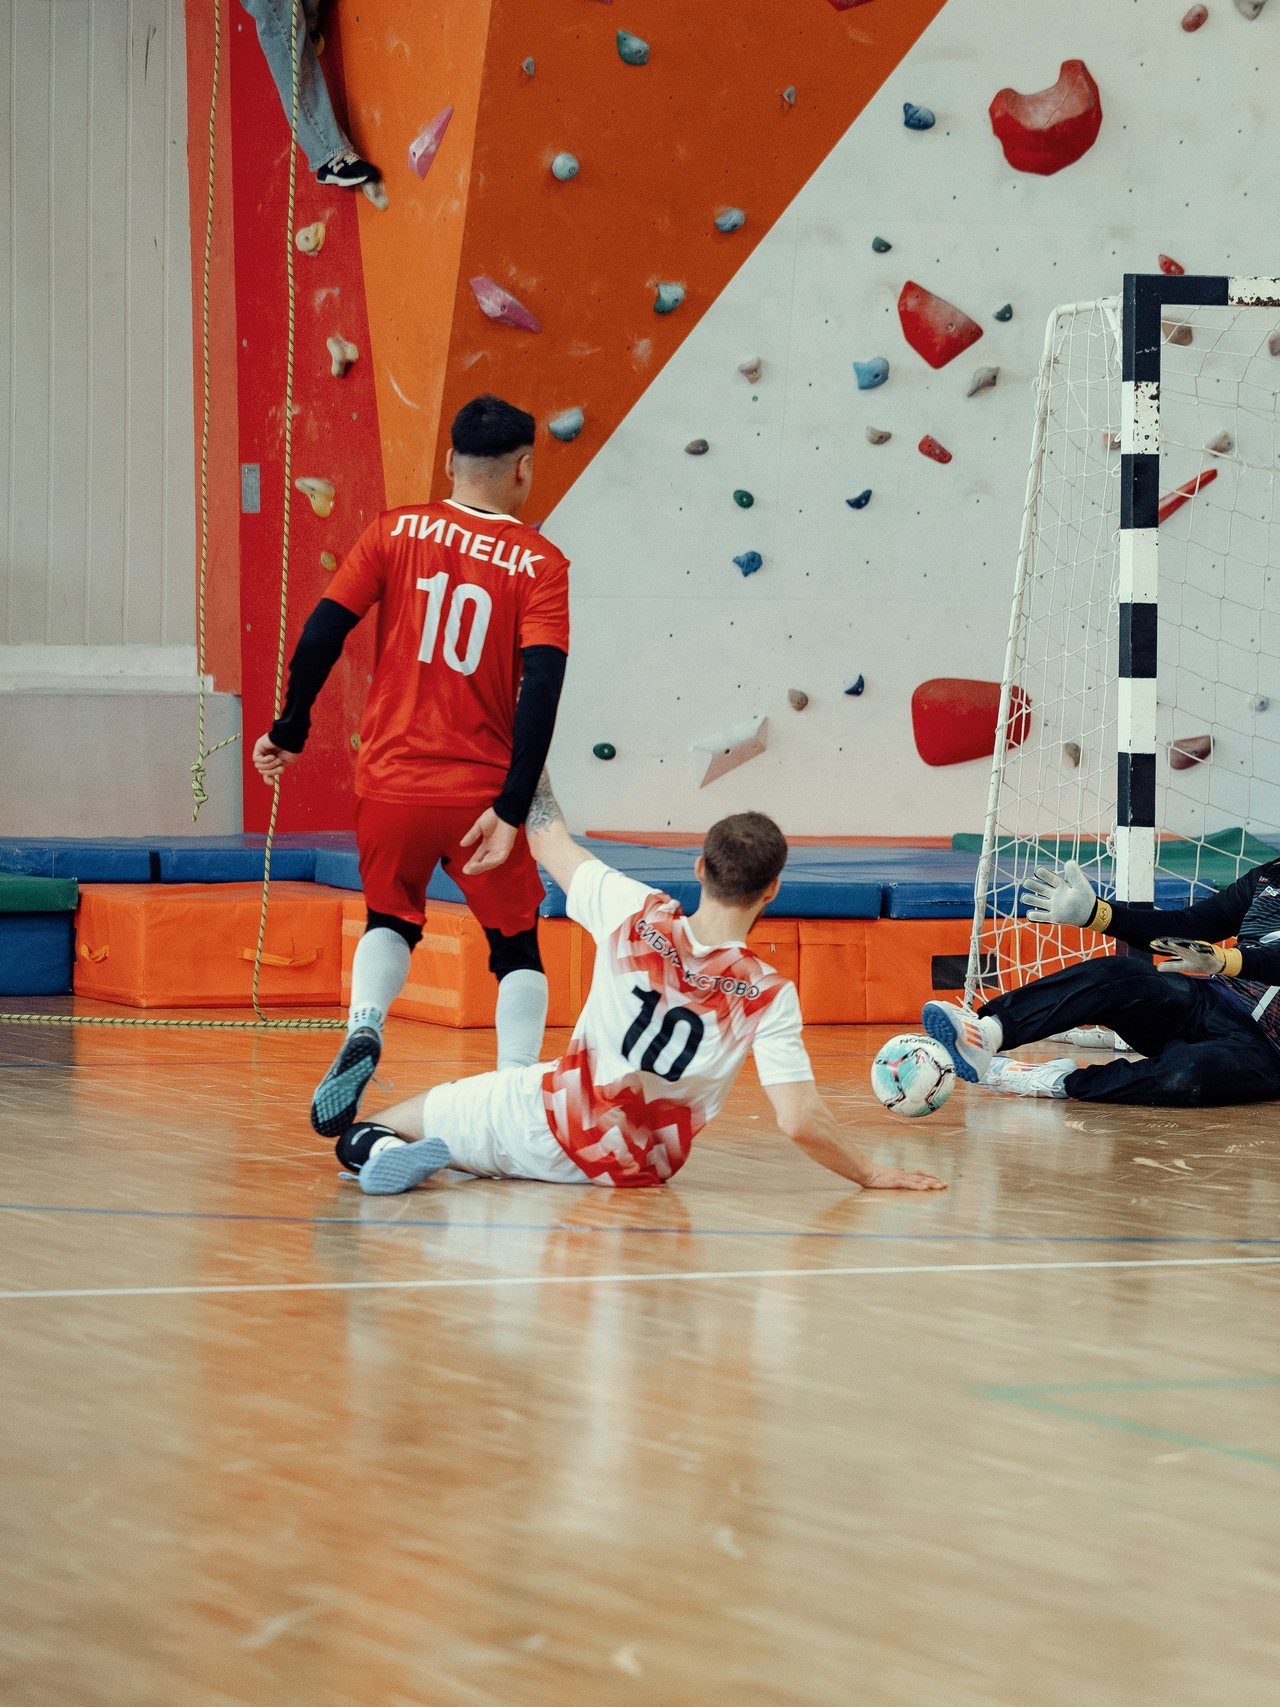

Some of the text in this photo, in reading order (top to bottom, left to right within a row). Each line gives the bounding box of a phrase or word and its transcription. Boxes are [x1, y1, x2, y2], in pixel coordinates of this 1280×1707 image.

[390, 514, 545, 578] ЛИПЕЦК
[416, 571, 493, 677] 10
[621, 985, 705, 1082] 10
